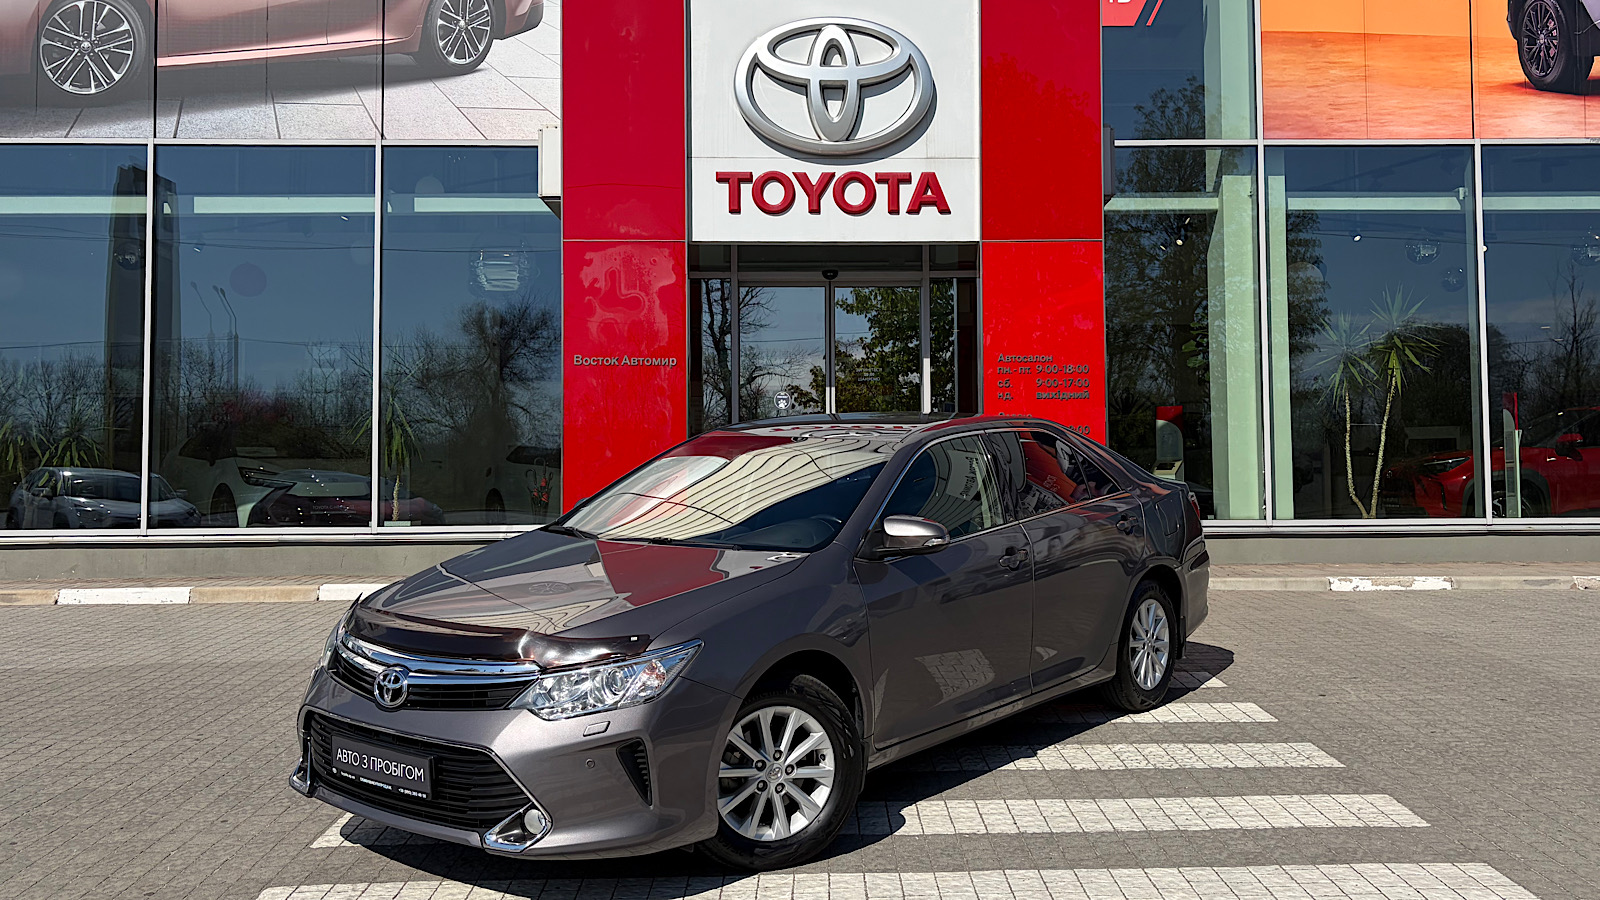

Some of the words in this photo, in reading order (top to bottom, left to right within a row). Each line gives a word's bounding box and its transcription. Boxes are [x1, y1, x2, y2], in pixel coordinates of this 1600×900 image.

[716, 171, 951, 216] TOYOTA
[573, 354, 619, 366] Восток
[621, 355, 677, 369] Автомир
[998, 353, 1053, 363] Автосалон
[1036, 364, 1090, 374] 9:00-18:00
[997, 379, 1013, 388] сб.
[1036, 378, 1090, 388] 9:00-17:00
[997, 392, 1014, 401] нд.
[1036, 390, 1090, 400] вихідний
[336, 748, 360, 766] АВТО
[370, 757, 424, 782] ПРОБІГОМ
